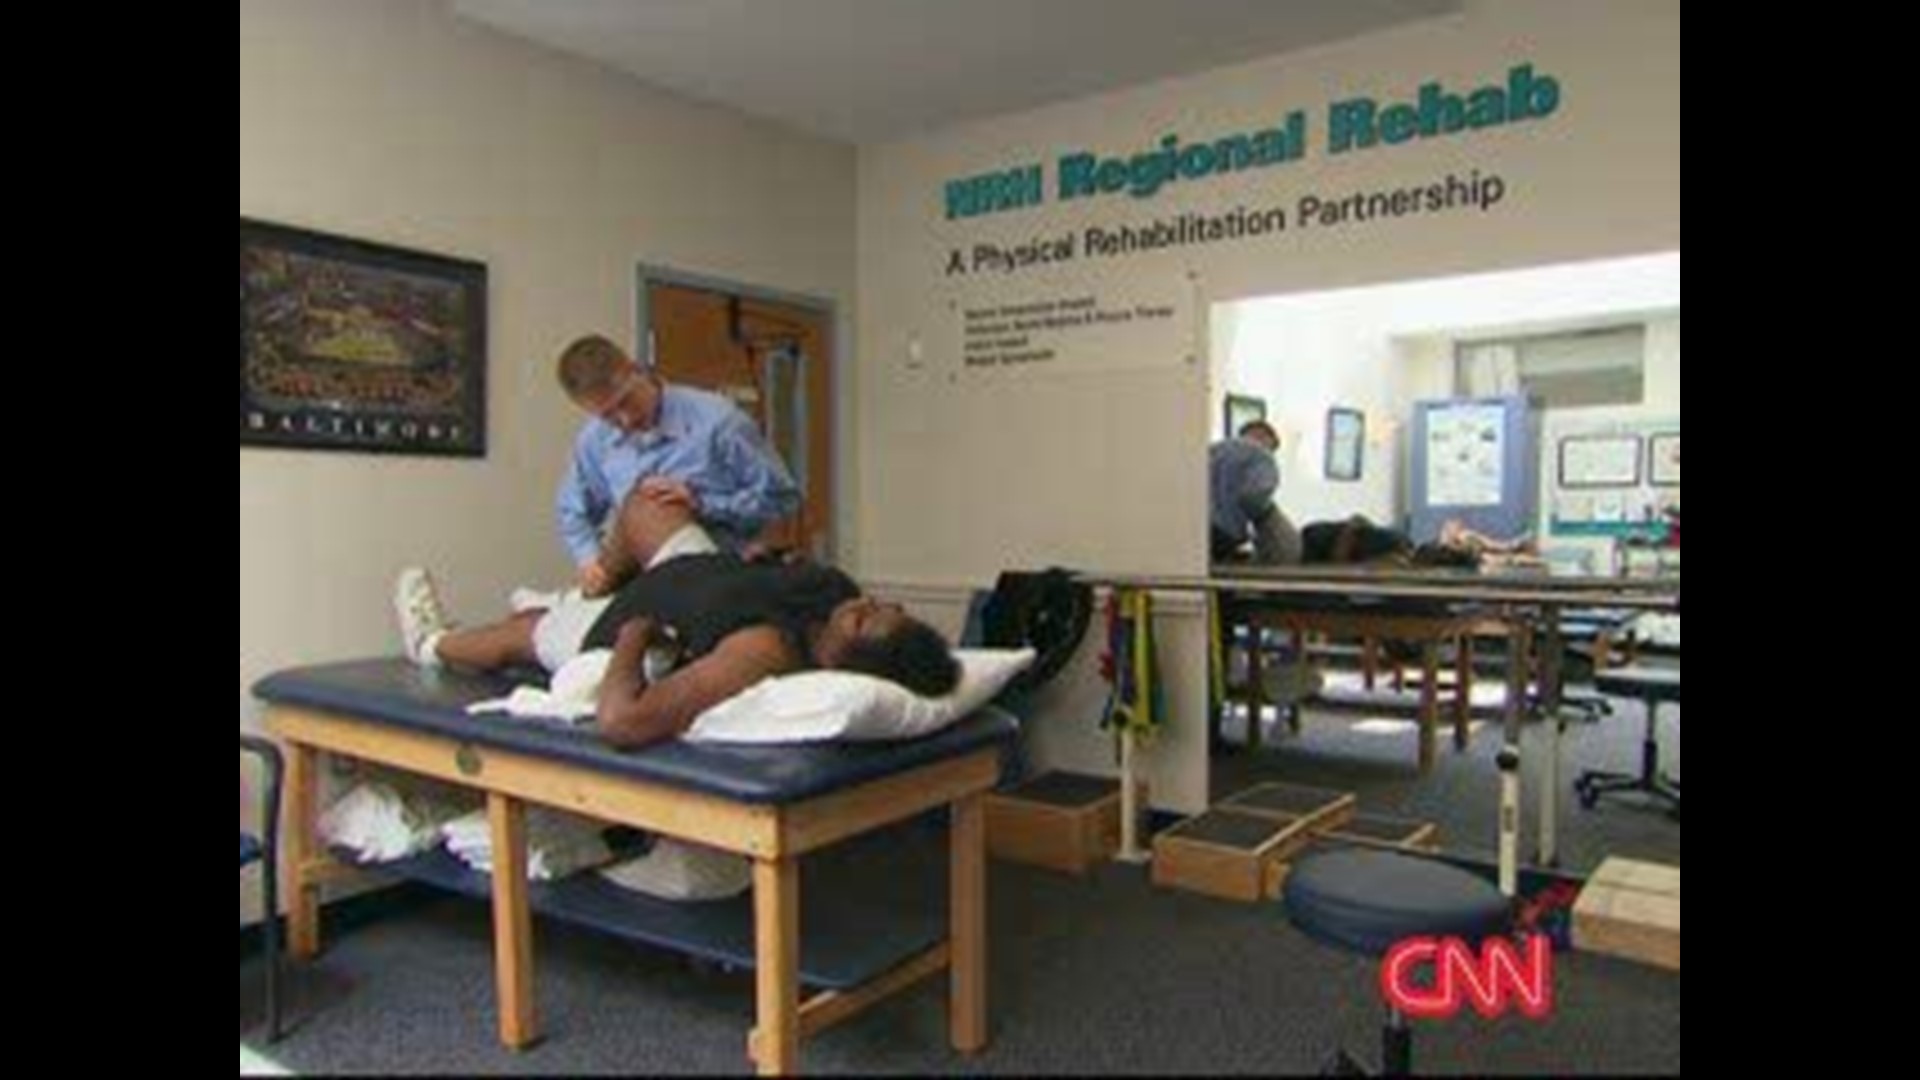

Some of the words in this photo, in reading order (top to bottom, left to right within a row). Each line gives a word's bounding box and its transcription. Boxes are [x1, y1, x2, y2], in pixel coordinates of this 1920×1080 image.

[1058, 110, 1305, 201] Regional
[1327, 62, 1561, 154] Rehab
[945, 249, 966, 276] A
[972, 232, 1076, 272] Physical
[1083, 206, 1287, 257] Rehabilitation
[1296, 169, 1505, 228] Partnership
